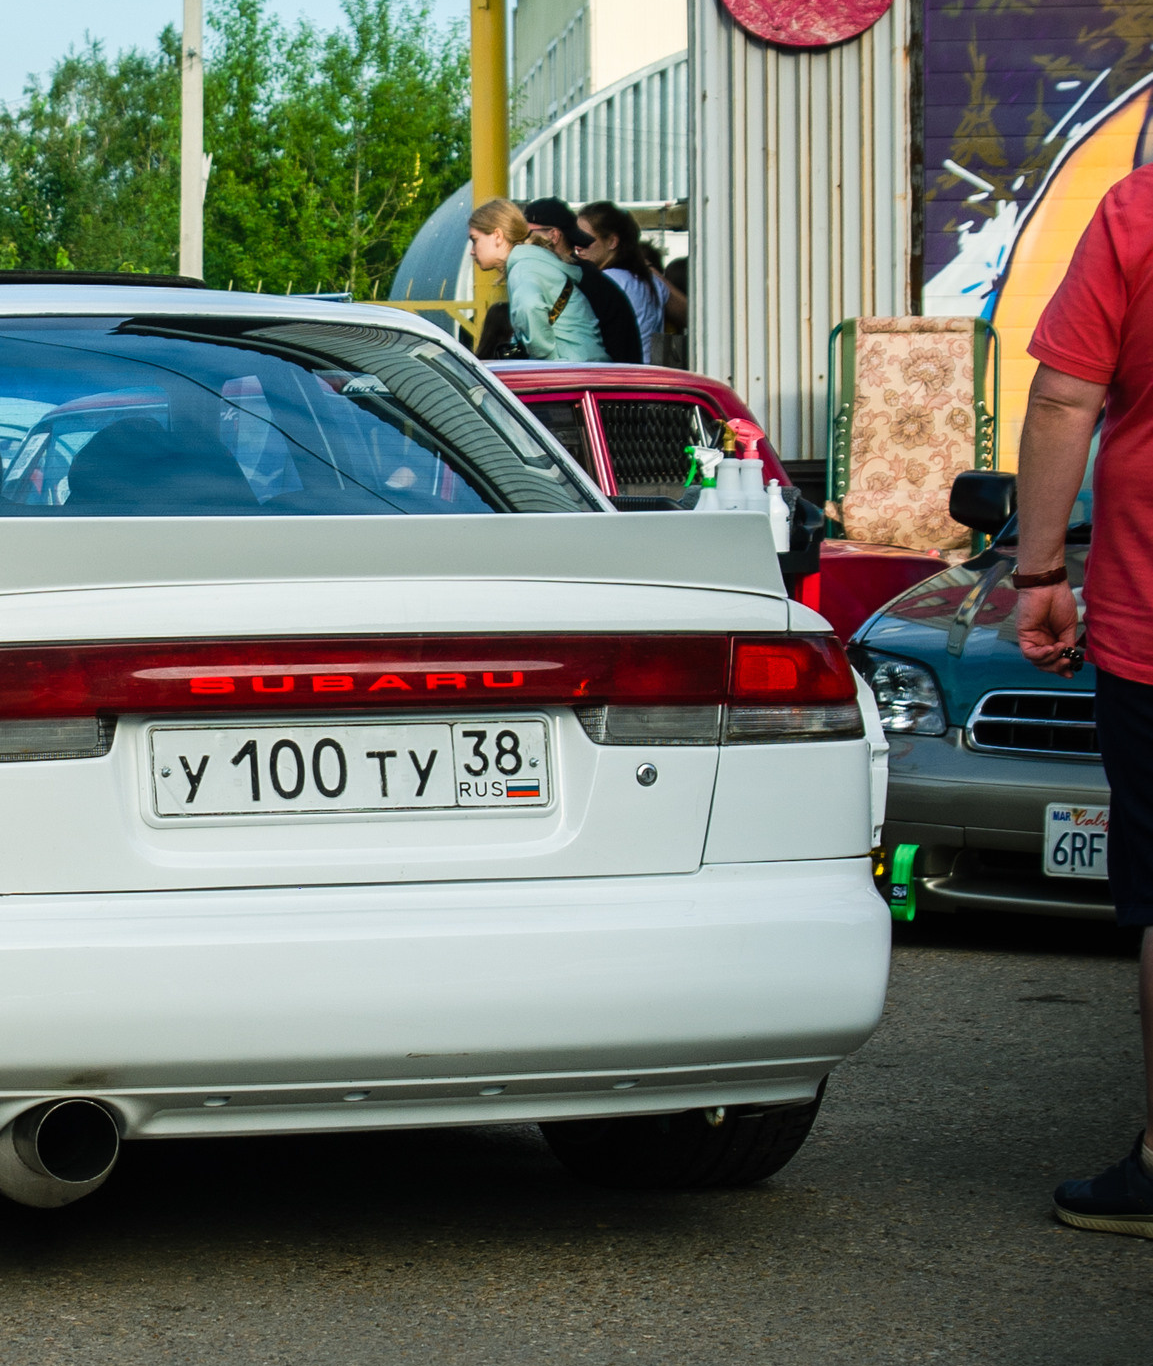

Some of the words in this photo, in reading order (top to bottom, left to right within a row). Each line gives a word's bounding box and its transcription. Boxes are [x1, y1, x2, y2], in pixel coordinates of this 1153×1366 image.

[190, 671, 525, 695] SUBARU
[230, 737, 347, 802] 100
[462, 729, 522, 776] 38
[459, 781, 504, 797] RUS
[1052, 810, 1071, 821] MAR
